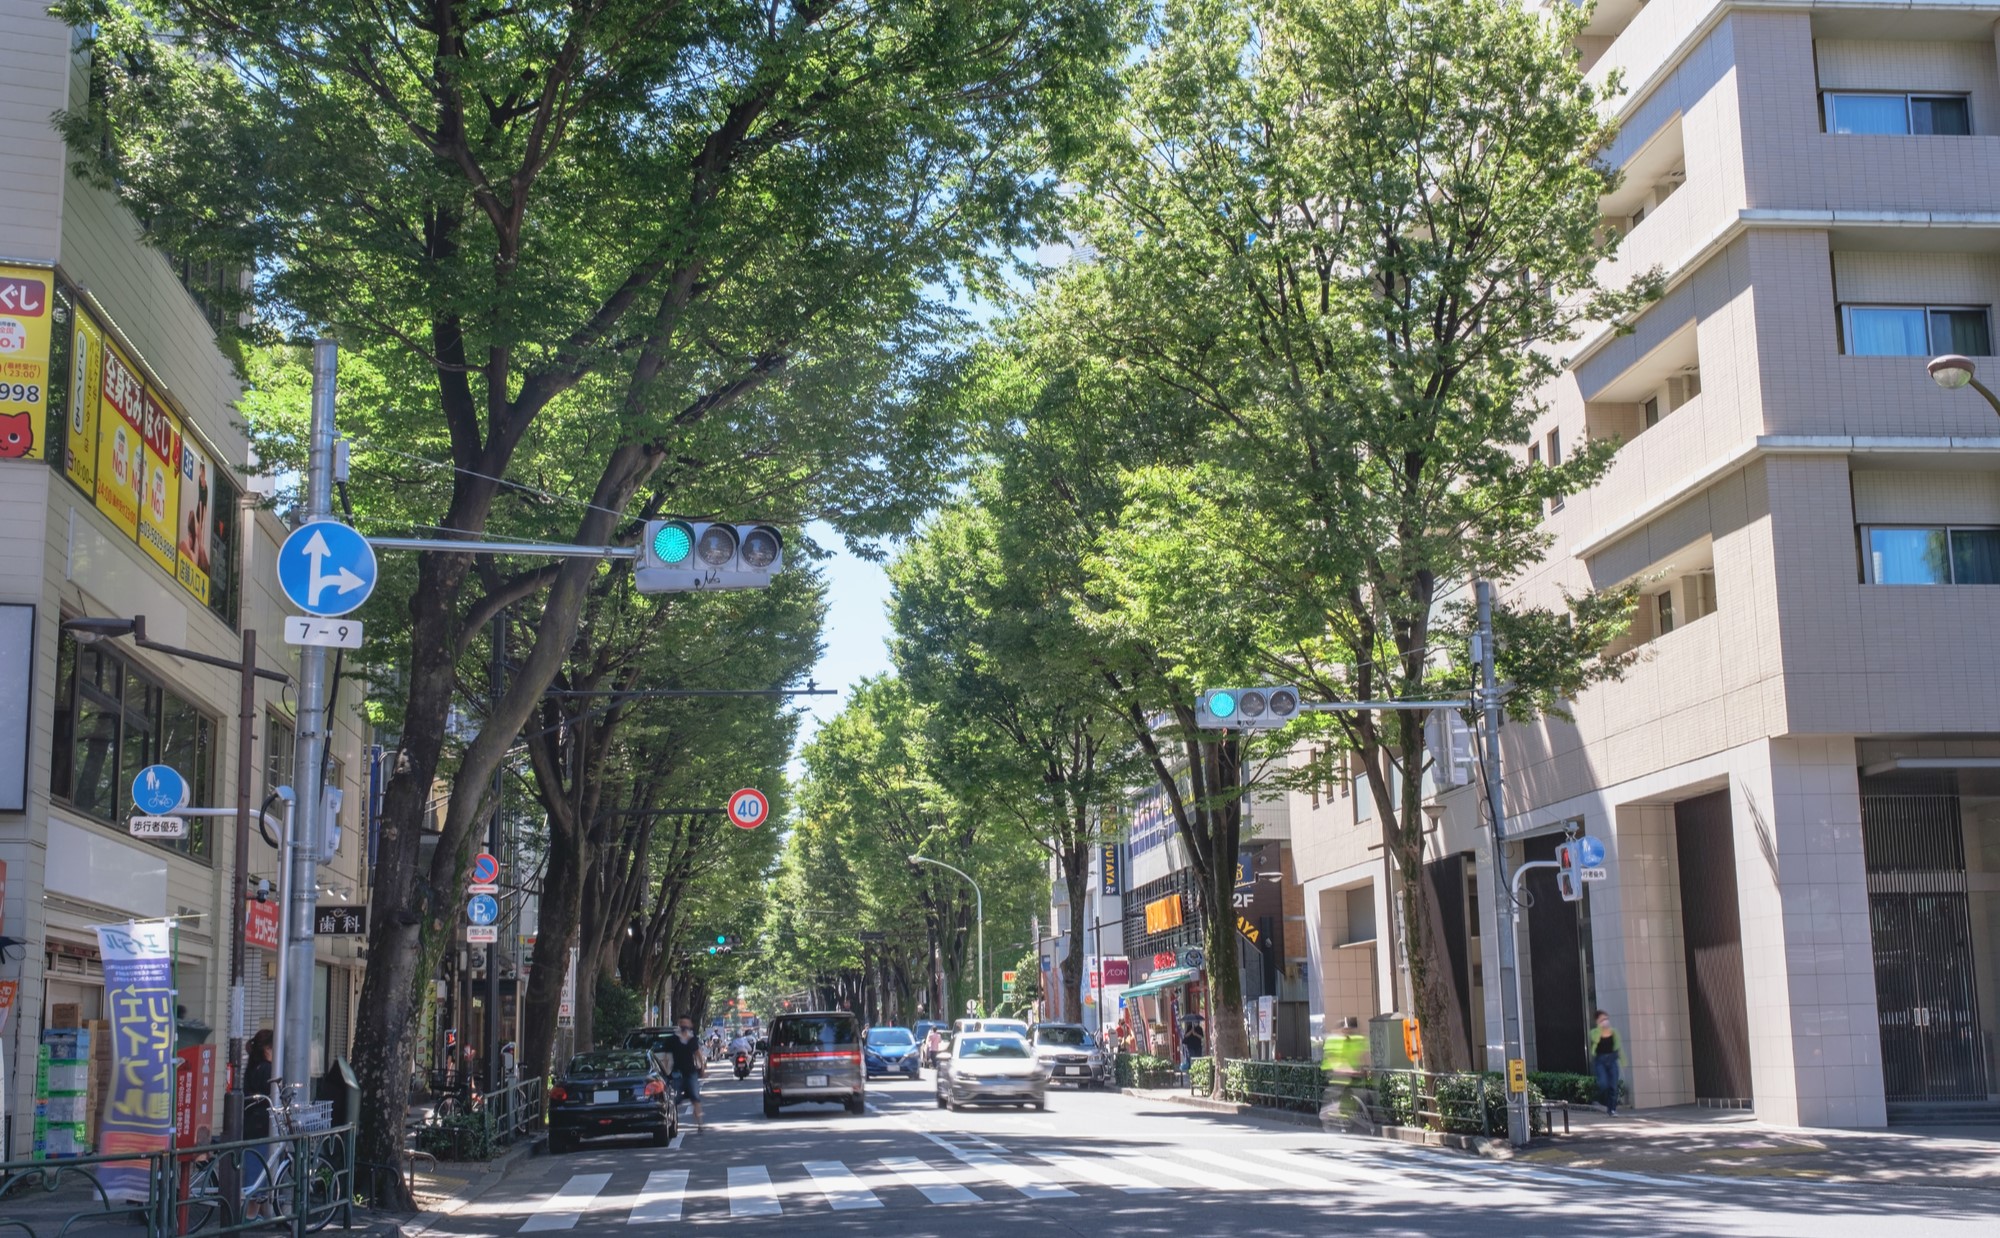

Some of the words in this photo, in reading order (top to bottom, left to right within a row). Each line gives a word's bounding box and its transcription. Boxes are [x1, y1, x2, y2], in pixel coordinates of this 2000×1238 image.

[184, 450, 193, 476] 3F
[180, 558, 200, 593] 店舗入口
[738, 800, 759, 817] 40
[134, 821, 179, 833] 歩行者優先
[1581, 871, 1605, 879] 行者優先
[1105, 886, 1116, 894] 2F
[1232, 893, 1255, 908] 2F
[319, 915, 360, 933] 歯科
